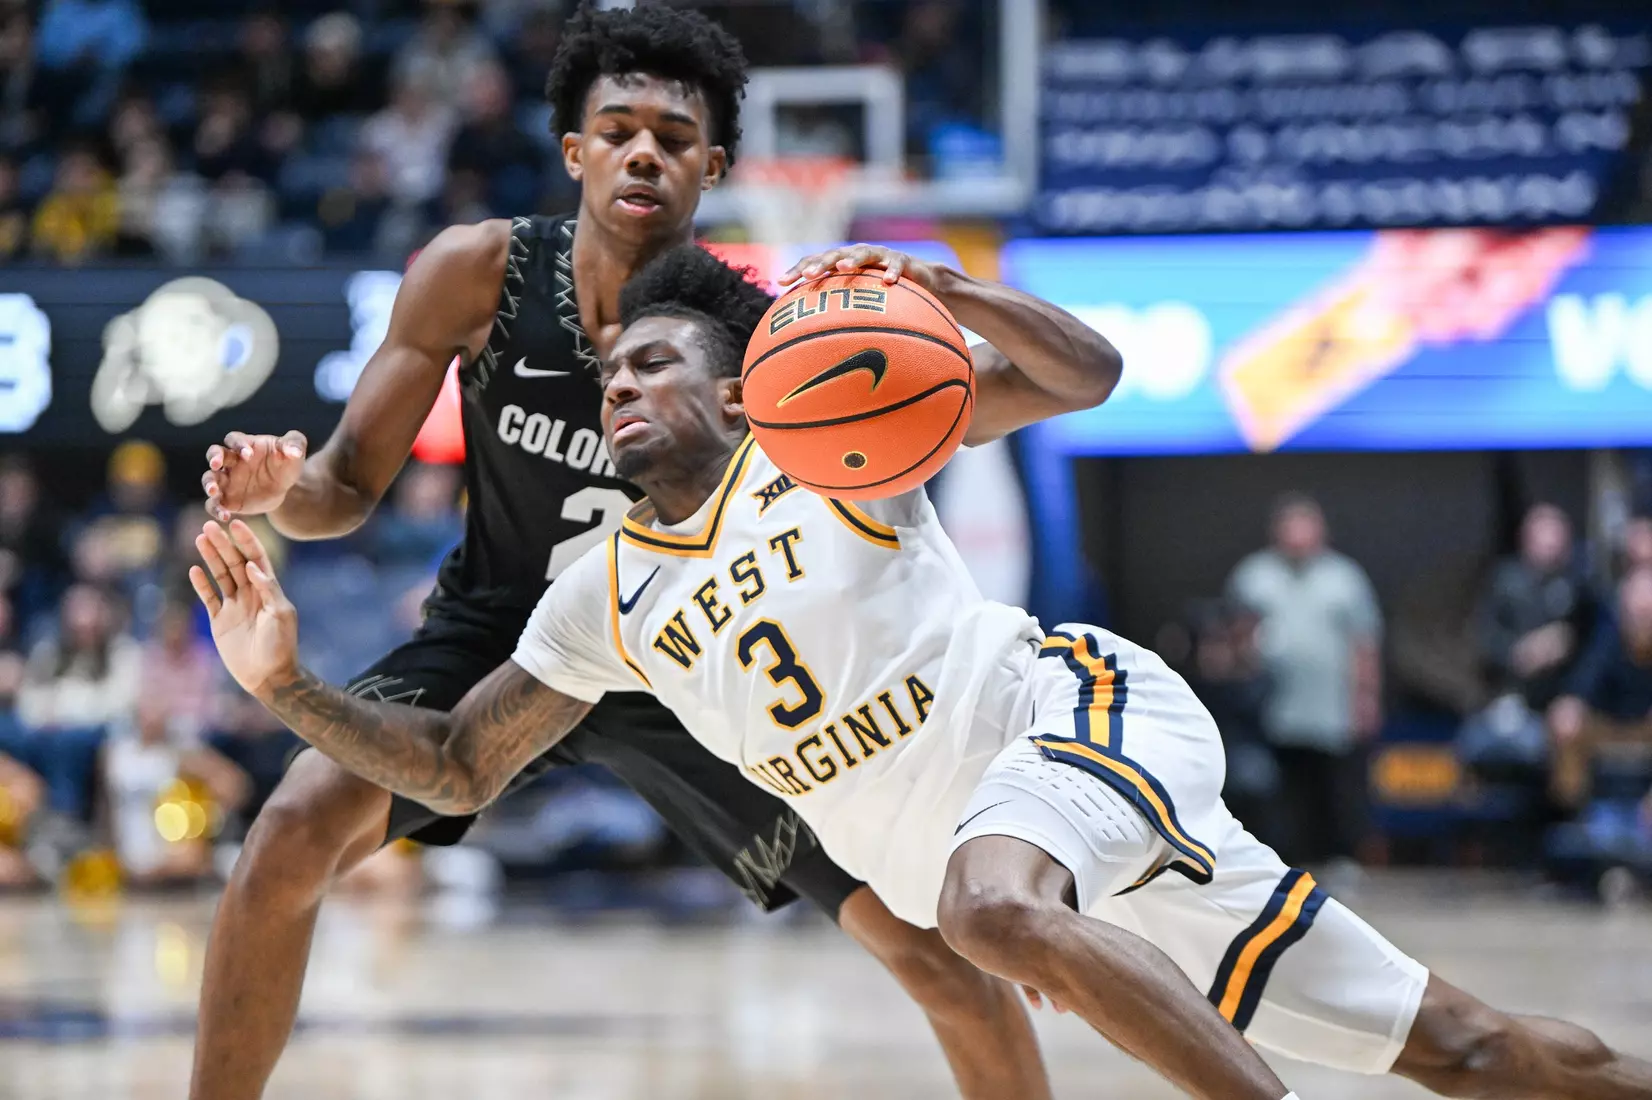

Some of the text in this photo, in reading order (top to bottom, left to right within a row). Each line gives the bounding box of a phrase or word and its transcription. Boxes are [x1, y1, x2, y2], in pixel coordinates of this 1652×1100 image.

[545, 486, 635, 581] 2
[652, 525, 806, 672] WEST
[735, 616, 827, 732] 3
